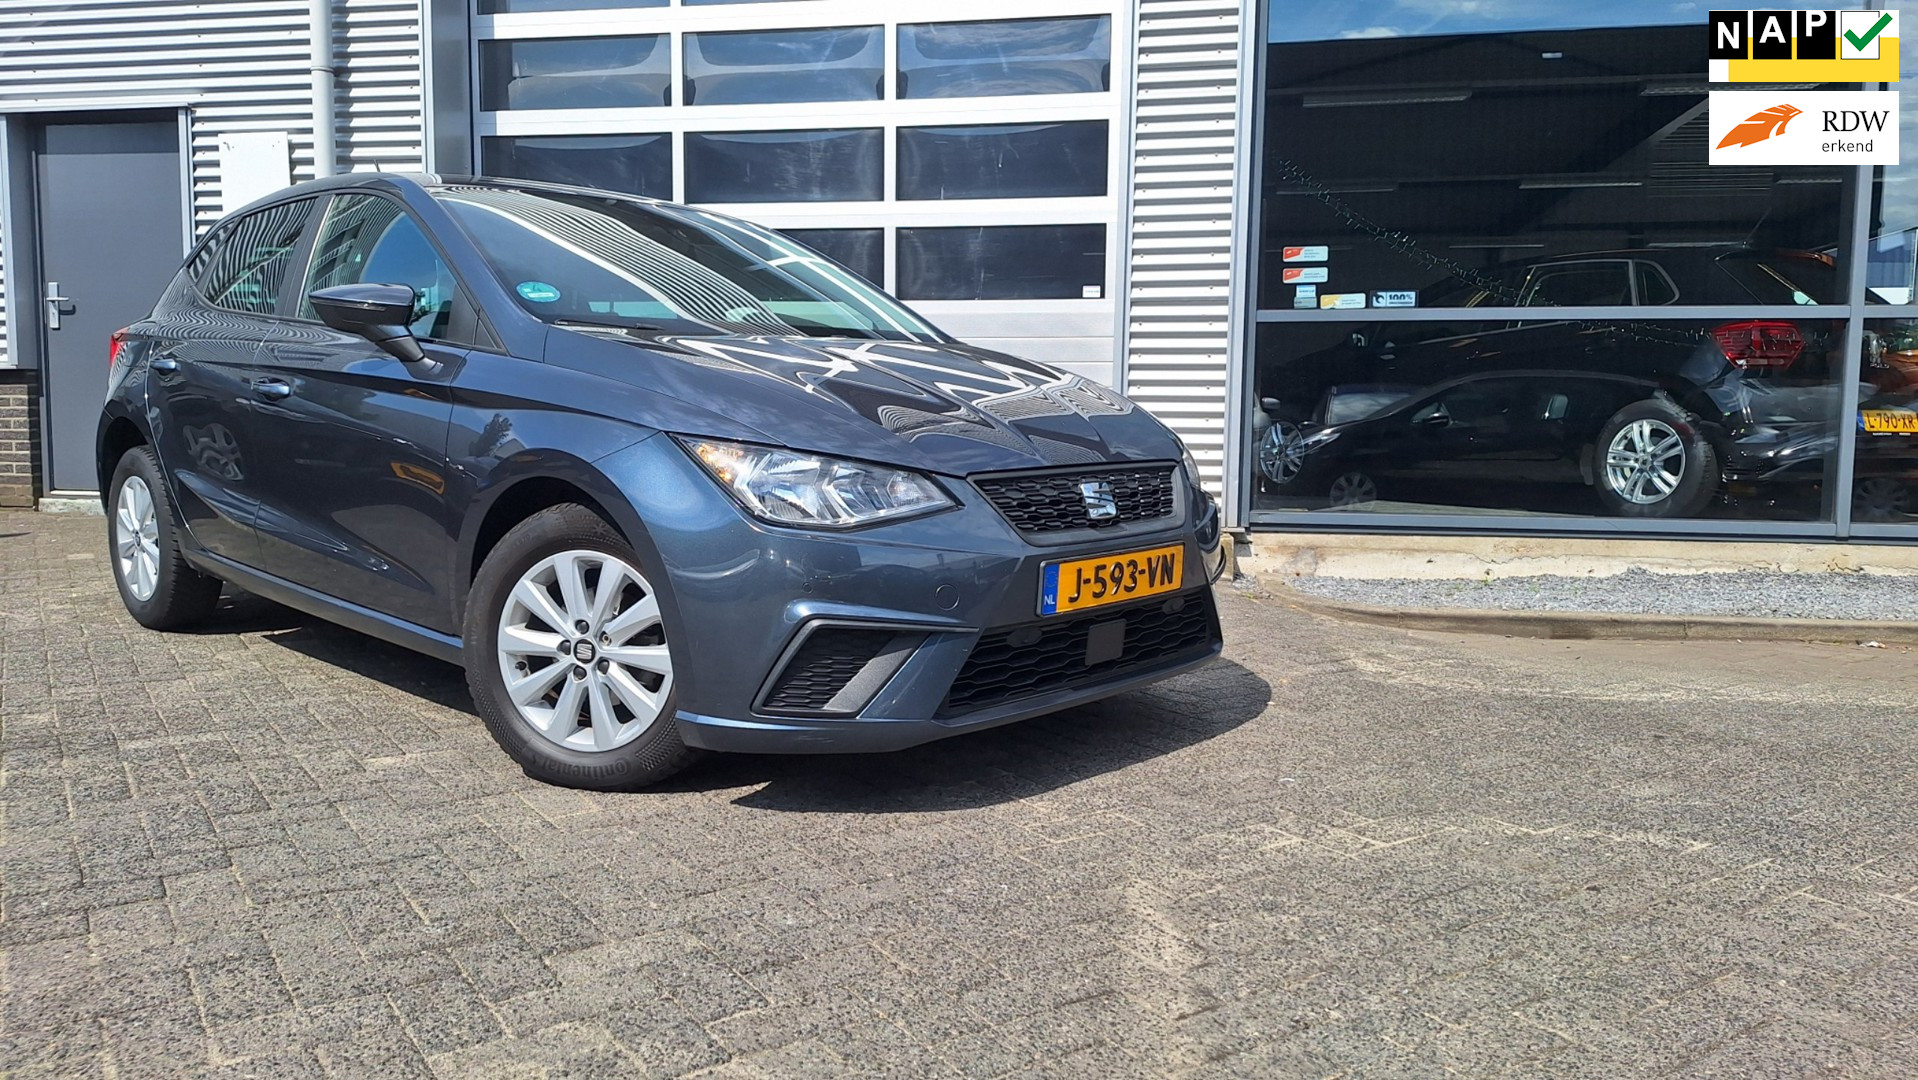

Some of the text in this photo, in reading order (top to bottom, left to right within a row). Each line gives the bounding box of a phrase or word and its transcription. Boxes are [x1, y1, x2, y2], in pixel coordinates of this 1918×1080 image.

[1866, 412, 1916, 429] L-790-XR
[1068, 552, 1175, 603] J-593-VN
[1044, 594, 1056, 605] NL
[541, 757, 631, 782] Continental
